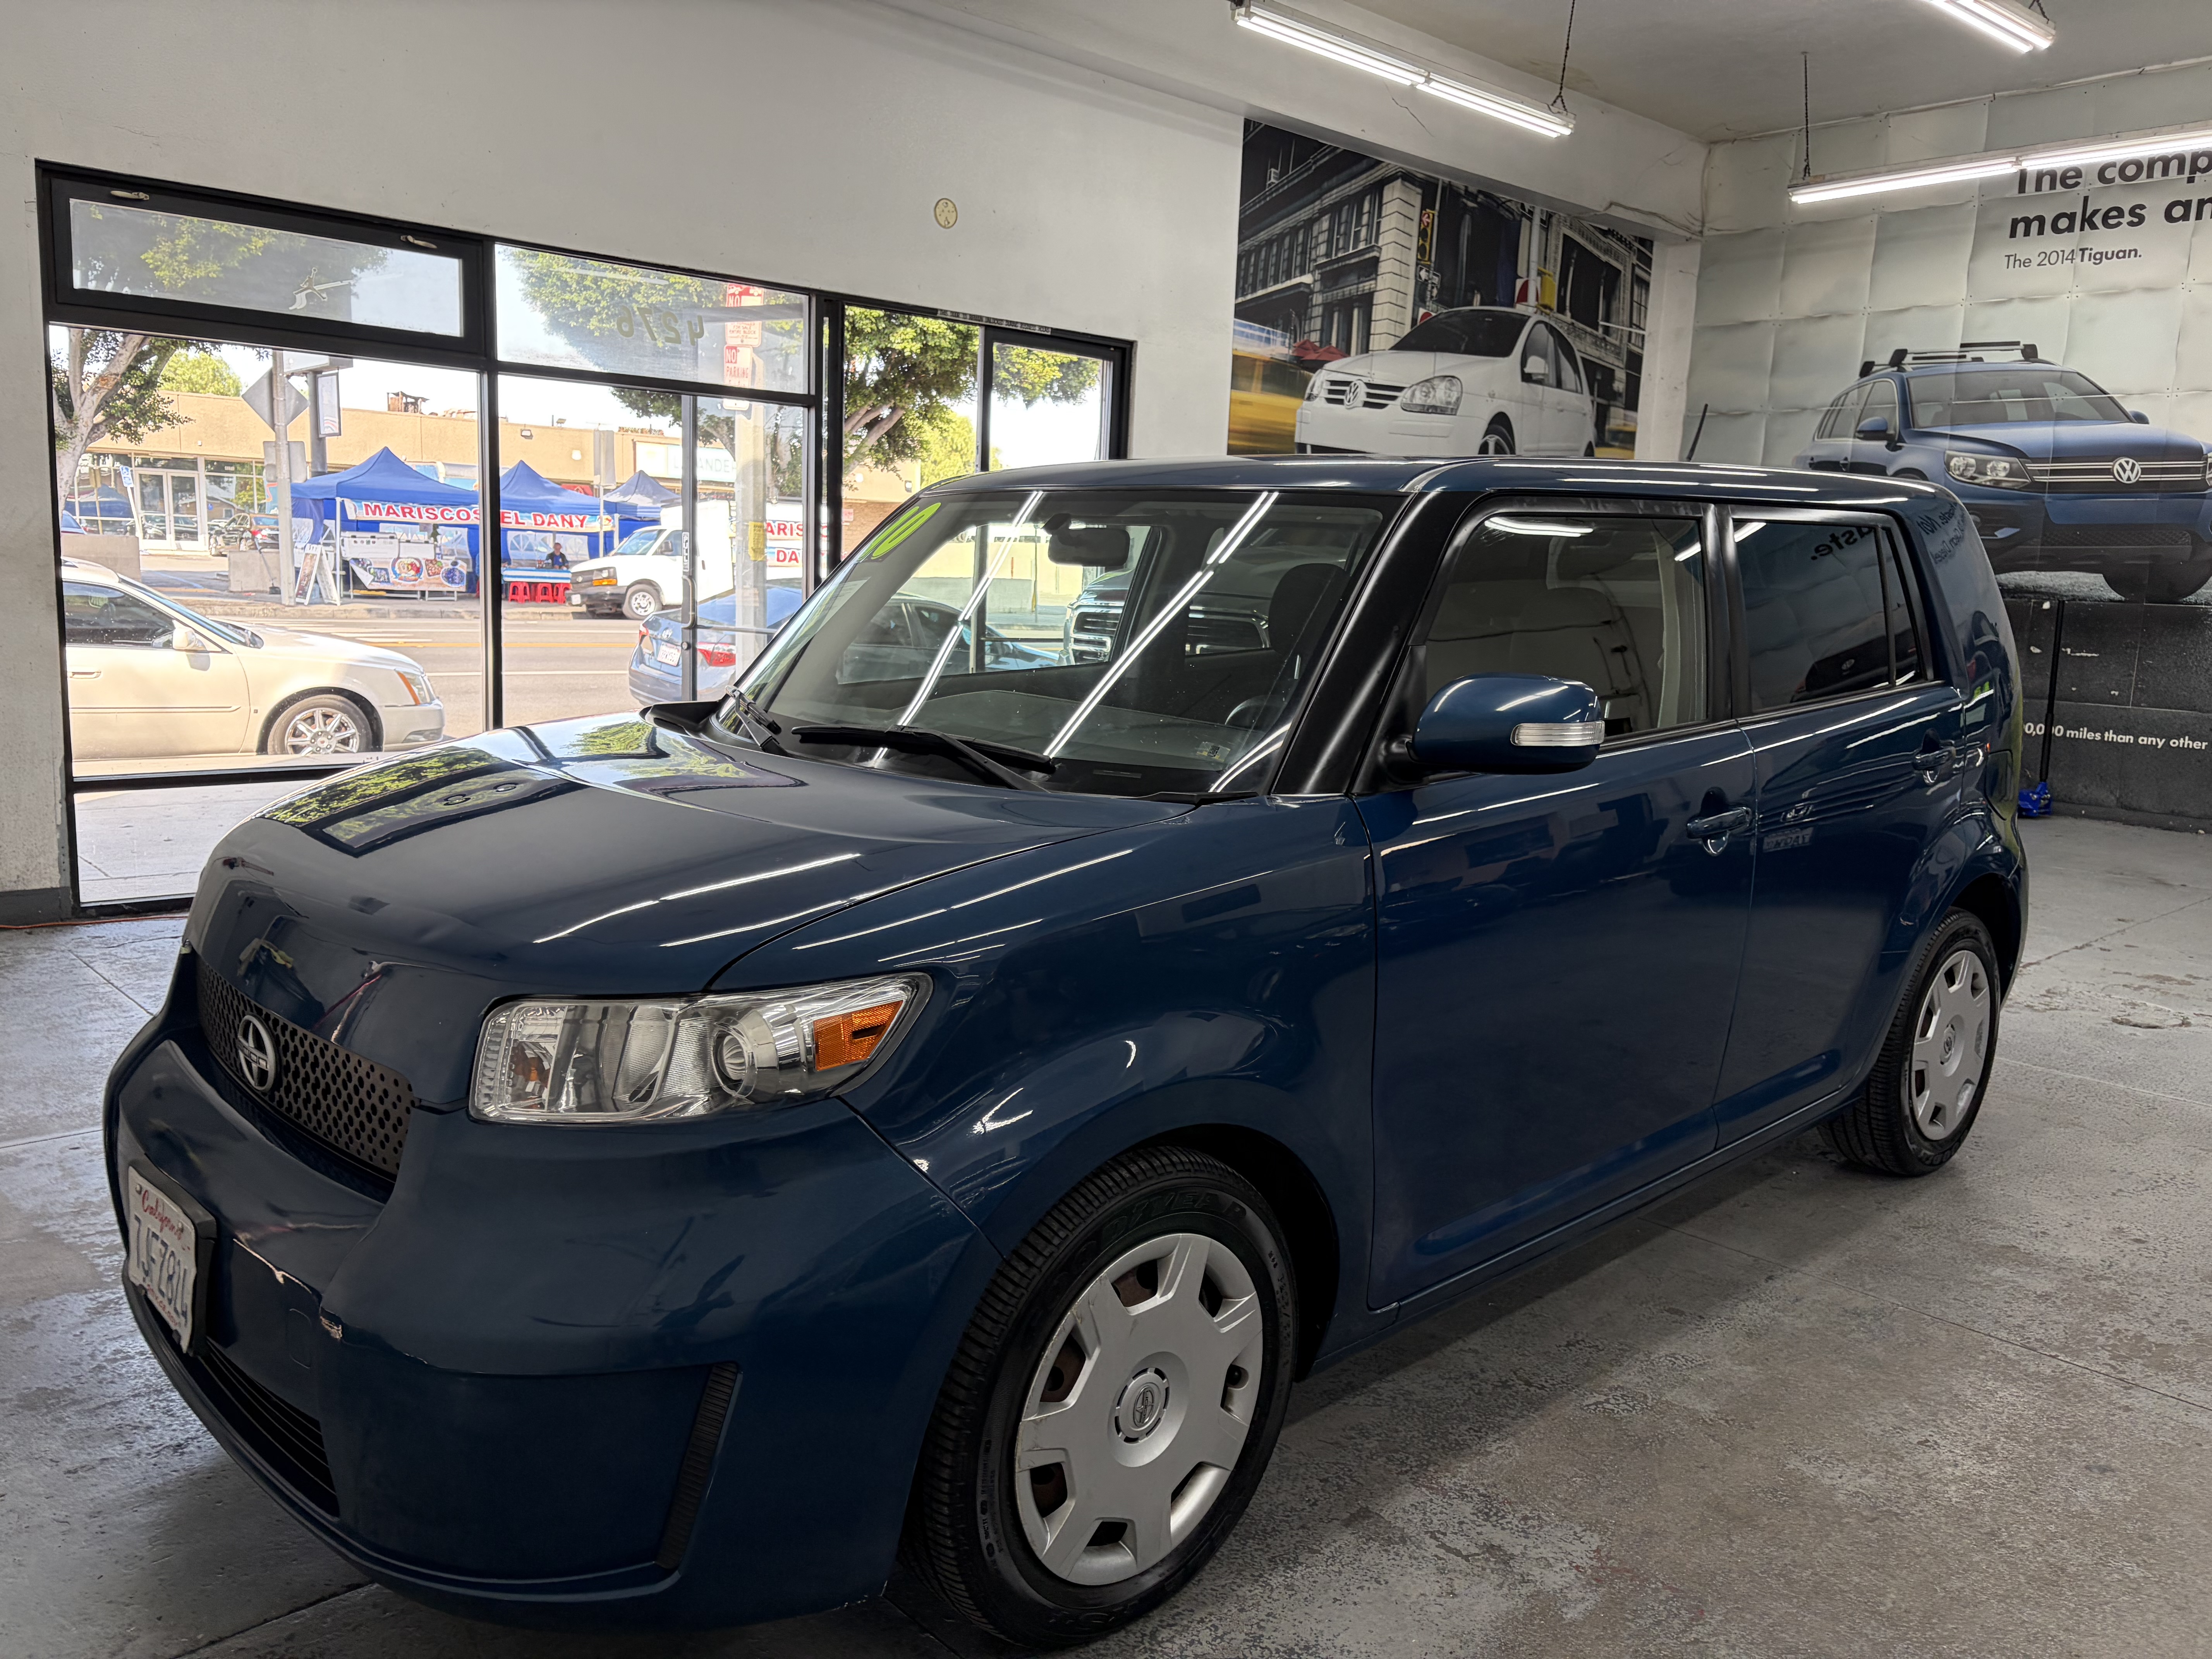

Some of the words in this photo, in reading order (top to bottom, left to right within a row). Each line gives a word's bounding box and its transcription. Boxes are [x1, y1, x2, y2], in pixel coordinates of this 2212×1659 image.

[2097, 150, 2212, 184] comp
[2009, 196, 2147, 239] makes
[2004, 253, 2032, 269] The
[2037, 249, 2076, 267] 2014
[2079, 247, 2142, 266] Tiguan.
[726, 349, 737, 363] NO
[726, 366, 749, 378] PARKING
[501, 510, 525, 525] EL
[533, 513, 587, 529] DANY
[766, 522, 803, 536] ARIS
[776, 550, 799, 563] DA
[2023, 722, 2064, 737] 0,00
[2066, 727, 2102, 741] miles
[2104, 730, 2134, 744] than
[2138, 737, 2166, 749] any
[2169, 737, 2208, 750] other
